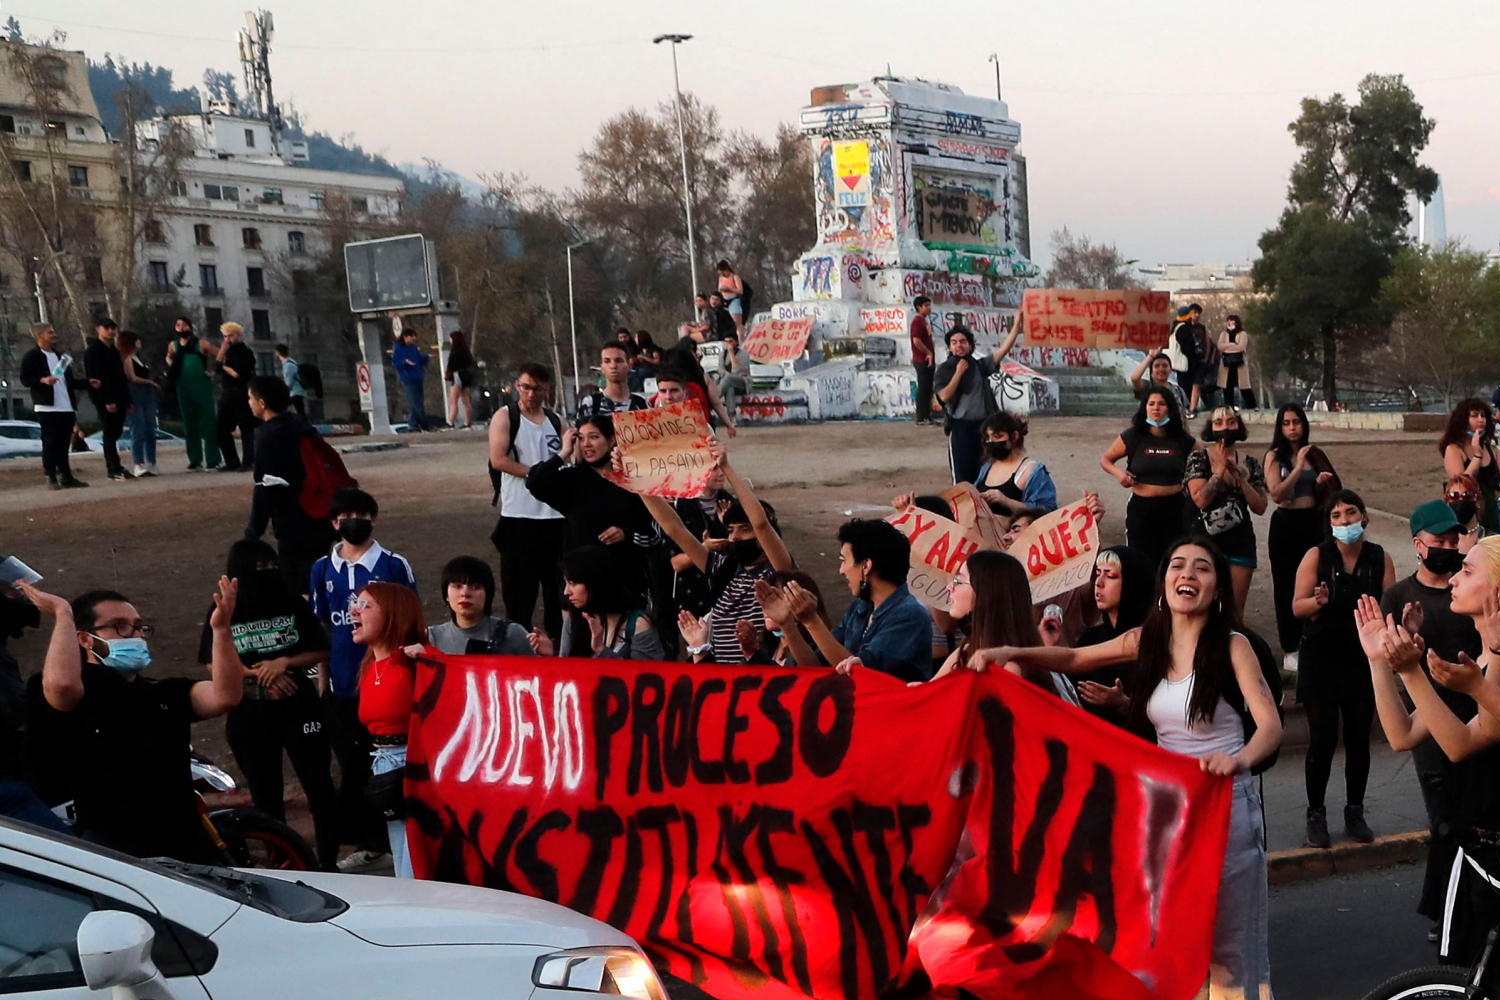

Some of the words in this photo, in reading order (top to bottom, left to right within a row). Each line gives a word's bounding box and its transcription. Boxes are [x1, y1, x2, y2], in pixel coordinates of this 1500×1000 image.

[838, 191, 867, 205] FELIZ
[1025, 295, 1056, 316] EL
[1057, 296, 1128, 318] TEATRO
[1137, 291, 1168, 313] NO
[637, 415, 697, 441] OLVIDES
[624, 460, 643, 479] EL
[649, 451, 705, 477] PASADO
[1027, 505, 1095, 576] QUÉ?
[303, 721, 322, 734] GAP
[434, 669, 586, 793] NUEVO
[593, 671, 857, 800] PROCESO
